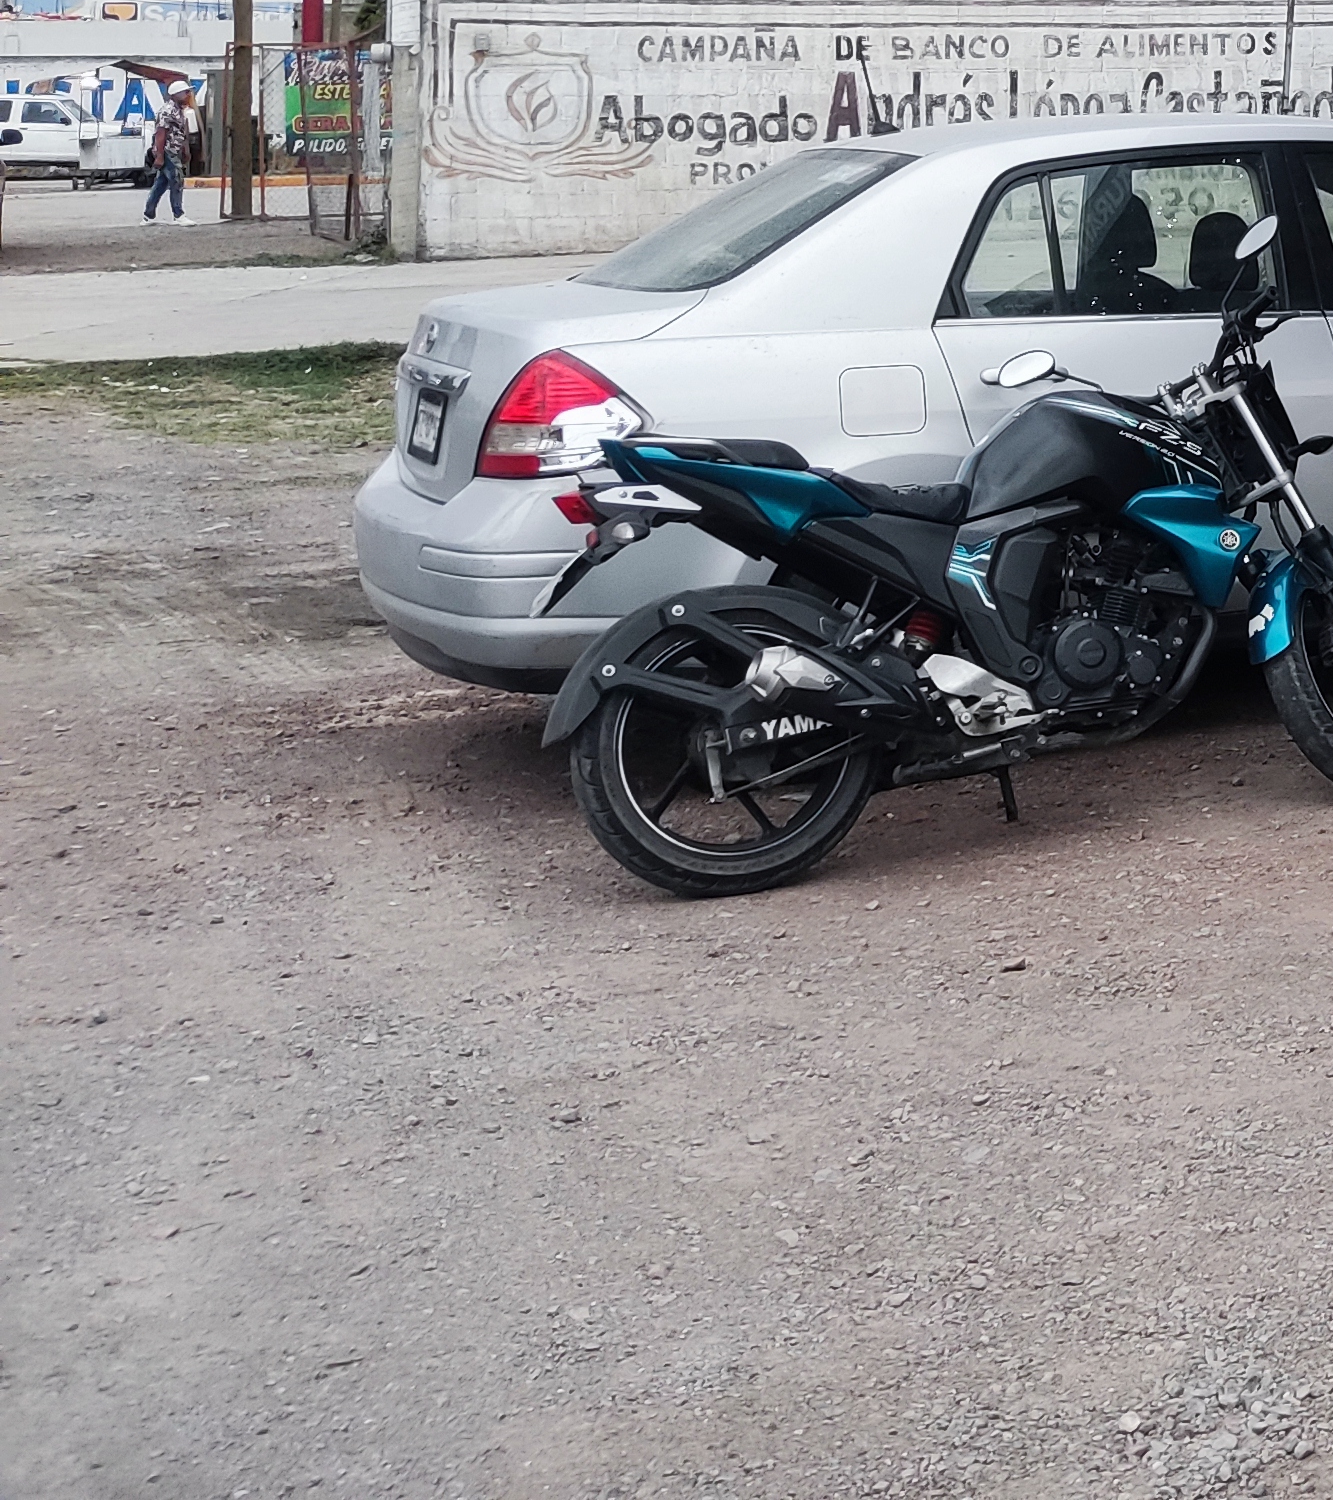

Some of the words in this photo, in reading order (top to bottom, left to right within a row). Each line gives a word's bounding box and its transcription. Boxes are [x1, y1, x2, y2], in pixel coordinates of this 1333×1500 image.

[637, 27, 802, 63] CAMPAÑA
[834, 34, 870, 61] DE
[891, 33, 1010, 60] BANCO
[1043, 33, 1080, 58] DE
[1096, 30, 1278, 59] ALIMENTOS
[593, 94, 818, 157] Abogado
